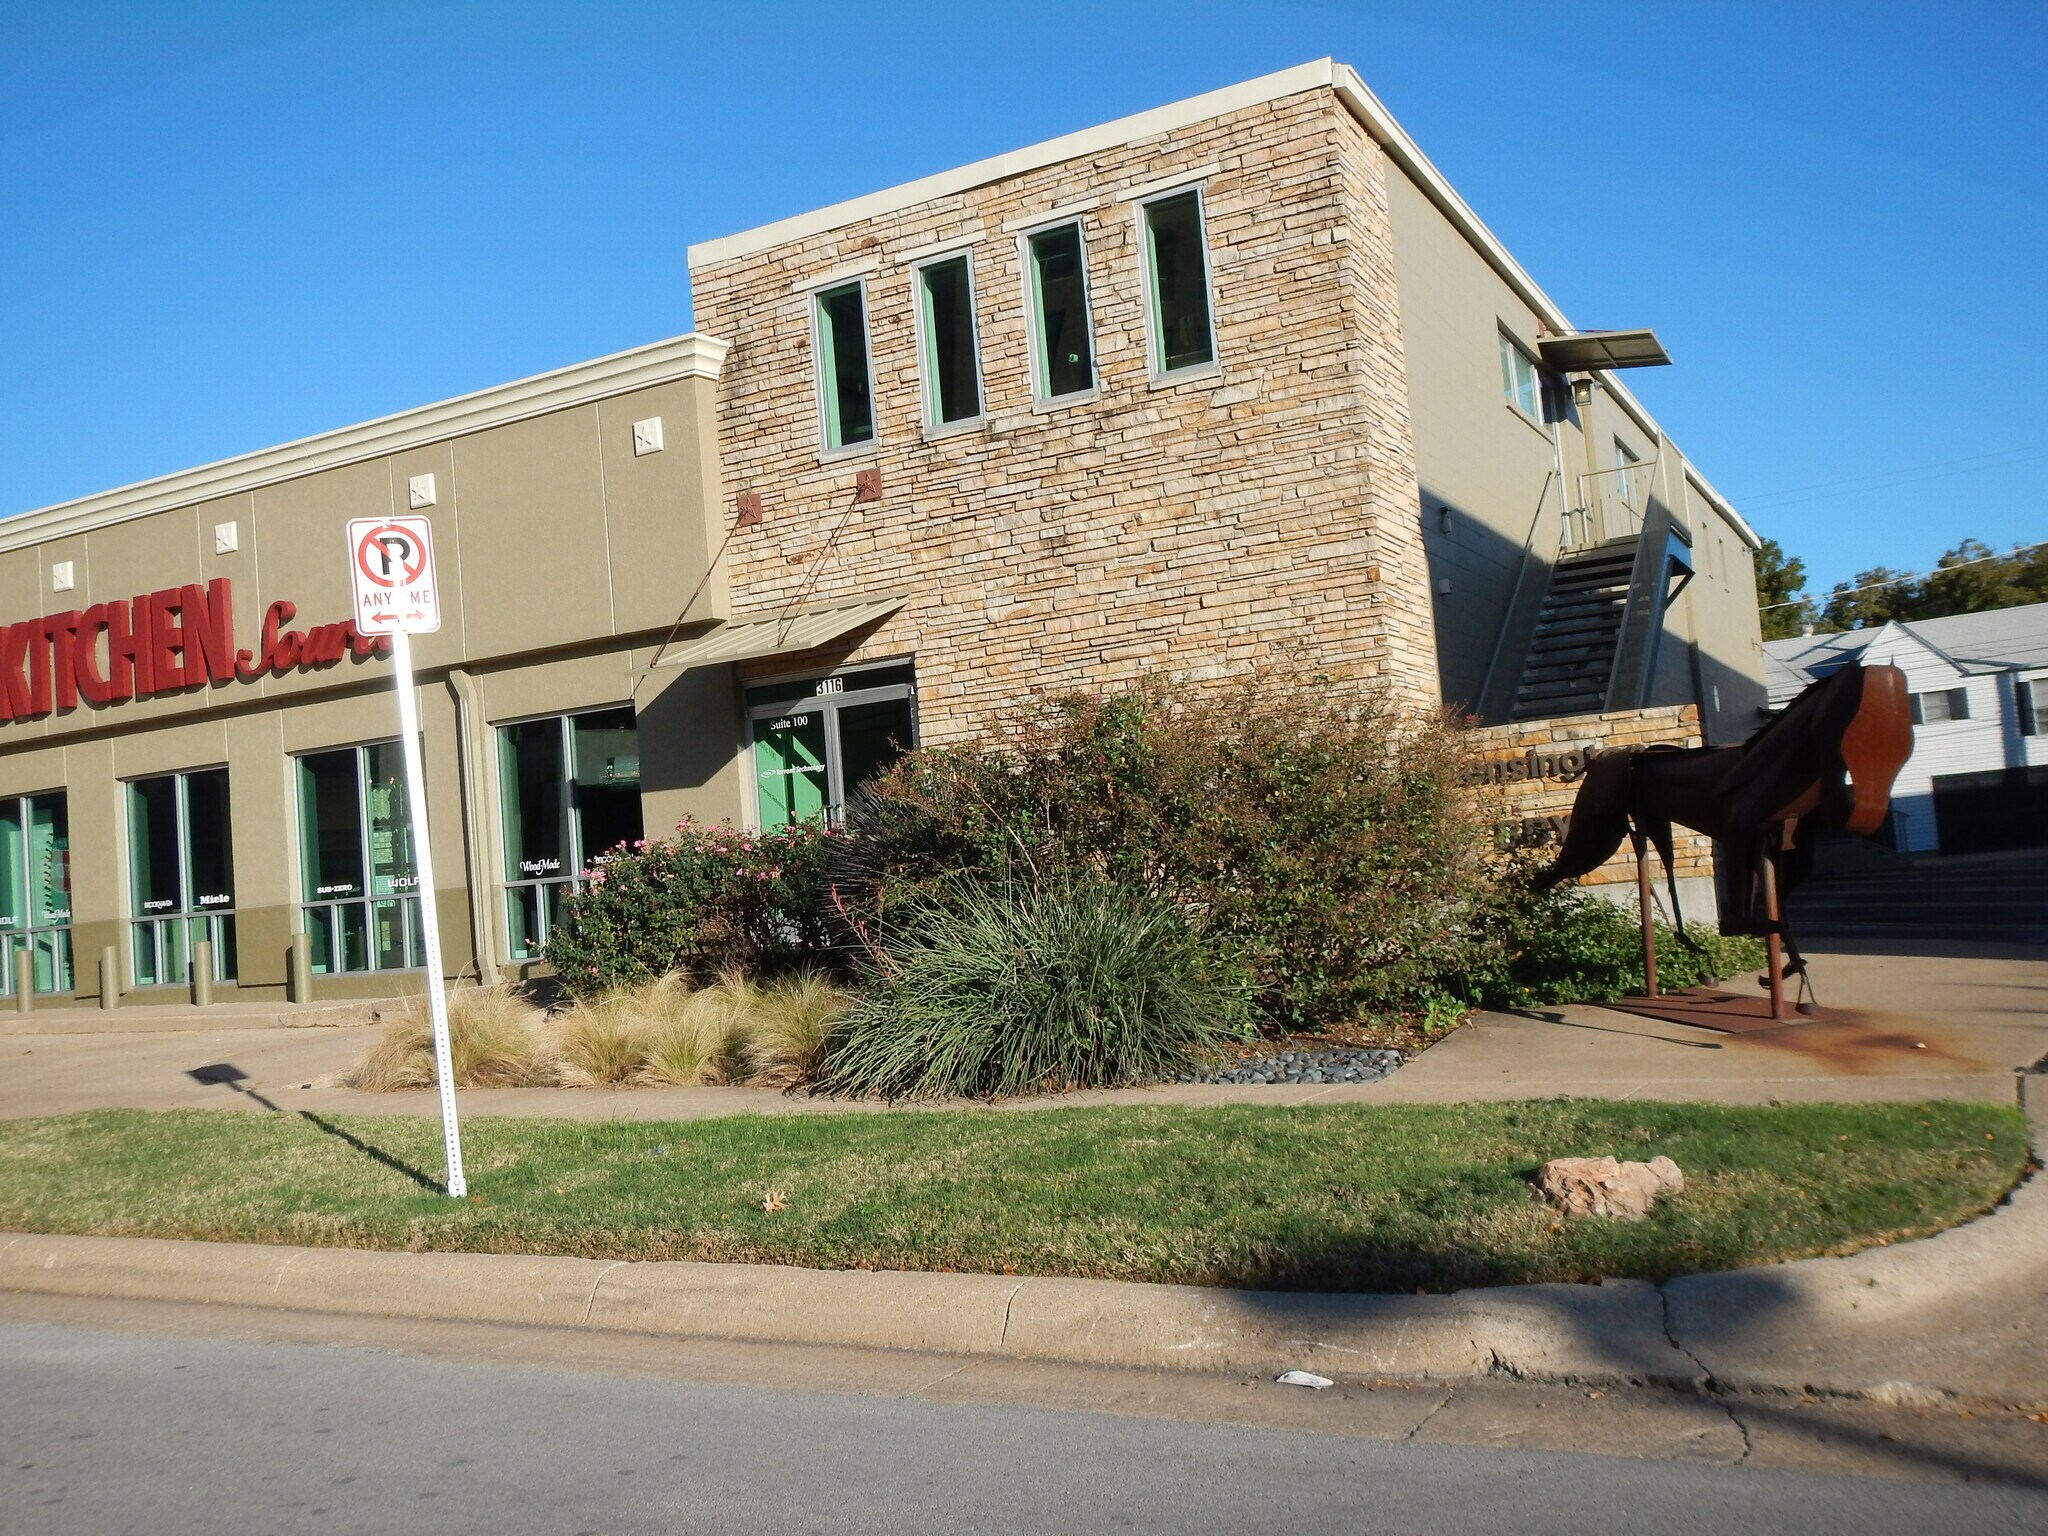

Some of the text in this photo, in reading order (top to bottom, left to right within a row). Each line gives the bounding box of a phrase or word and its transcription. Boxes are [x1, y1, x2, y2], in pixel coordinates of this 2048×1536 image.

[363, 591, 392, 607] ANY
[0, 577, 395, 719] KITCHEN Sourc
[817, 678, 842, 695] 3116
[770, 715, 808, 731] Suite 100
[199, 894, 230, 905] Miele
[0, 916, 19, 924] OLF
